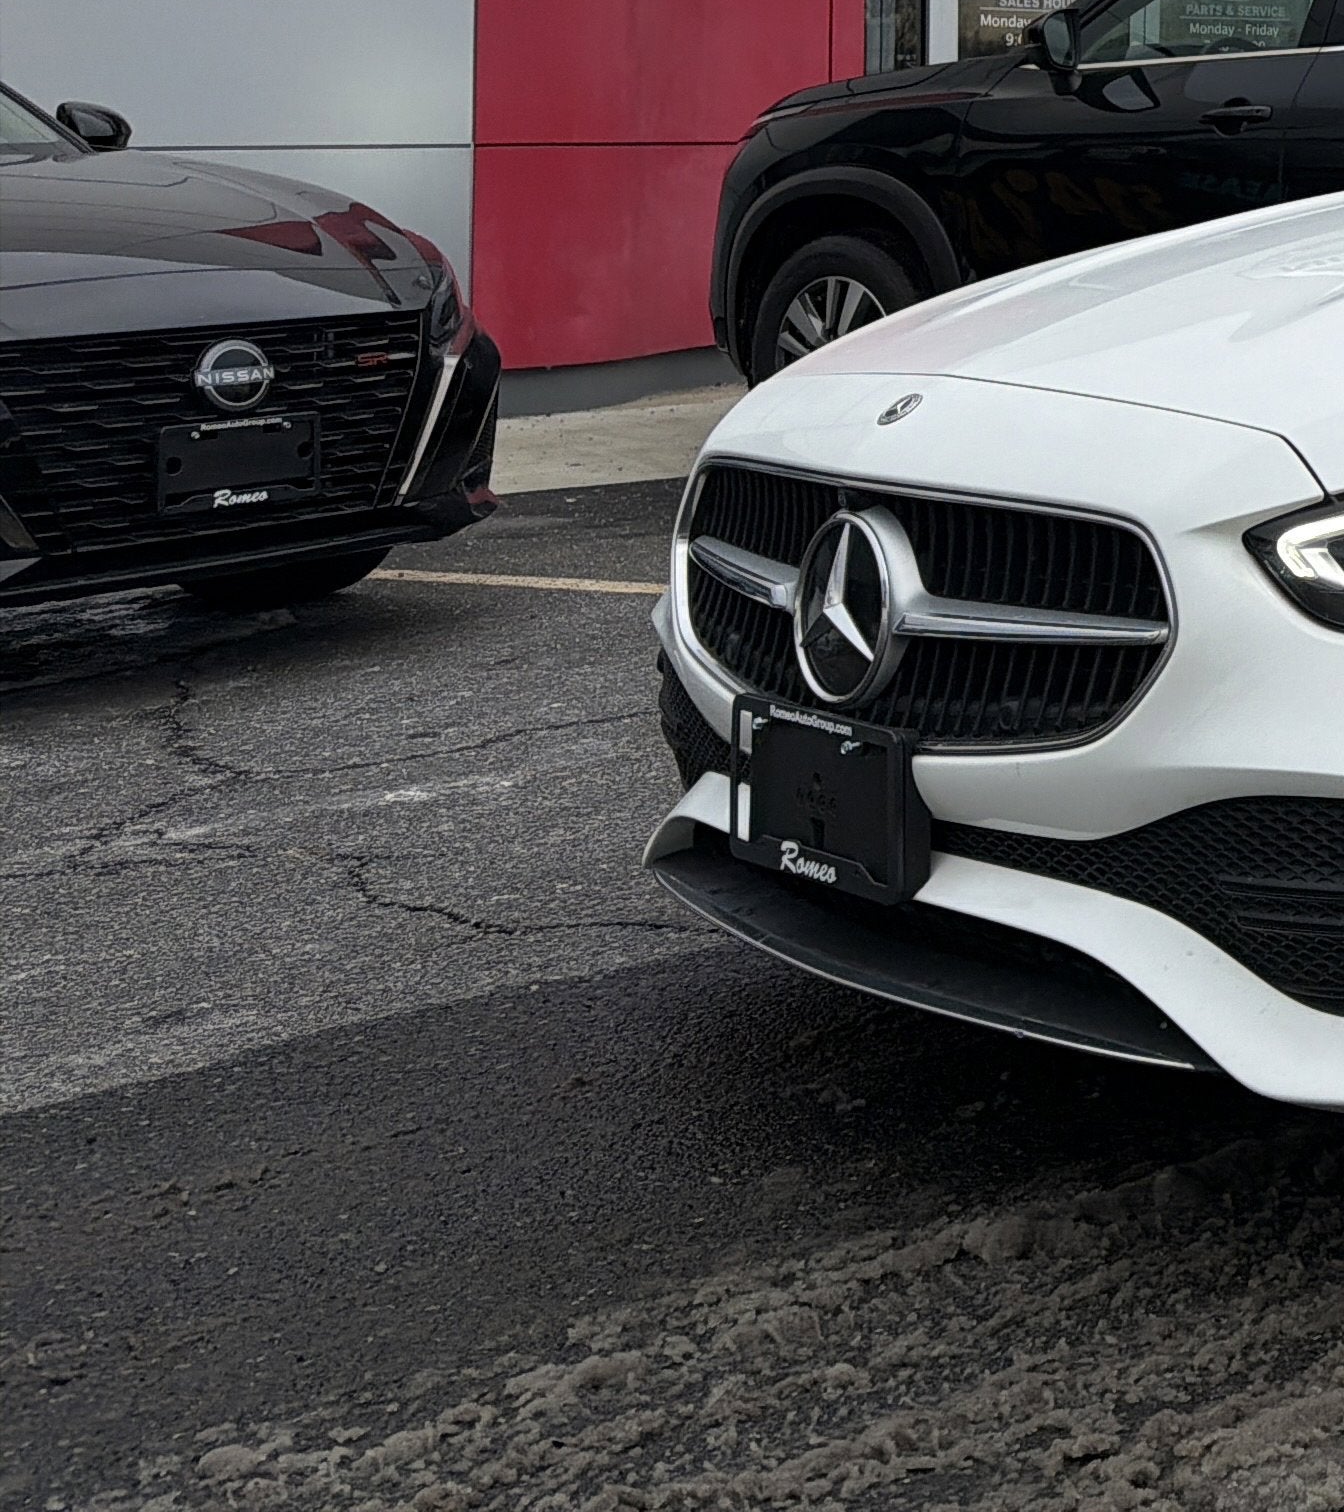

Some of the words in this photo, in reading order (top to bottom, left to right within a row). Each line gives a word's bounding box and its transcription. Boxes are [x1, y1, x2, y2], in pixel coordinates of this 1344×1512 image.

[1185, 4, 1222, 16] PARTS
[1226, 5, 1234, 16] &
[1237, 5, 1286, 17] SERVICE
[1189, 23, 1235, 36] Monday
[1245, 24, 1280, 38] Friday
[357, 352, 389, 367] SR
[198, 366, 275, 385] NISSAN
[200, 418, 283, 432] RomeoAutoGroup.com
[212, 489, 269, 508] Romeo
[769, 704, 853, 737] RomeoAutoGroup.com
[779, 840, 838, 884] Romeo
